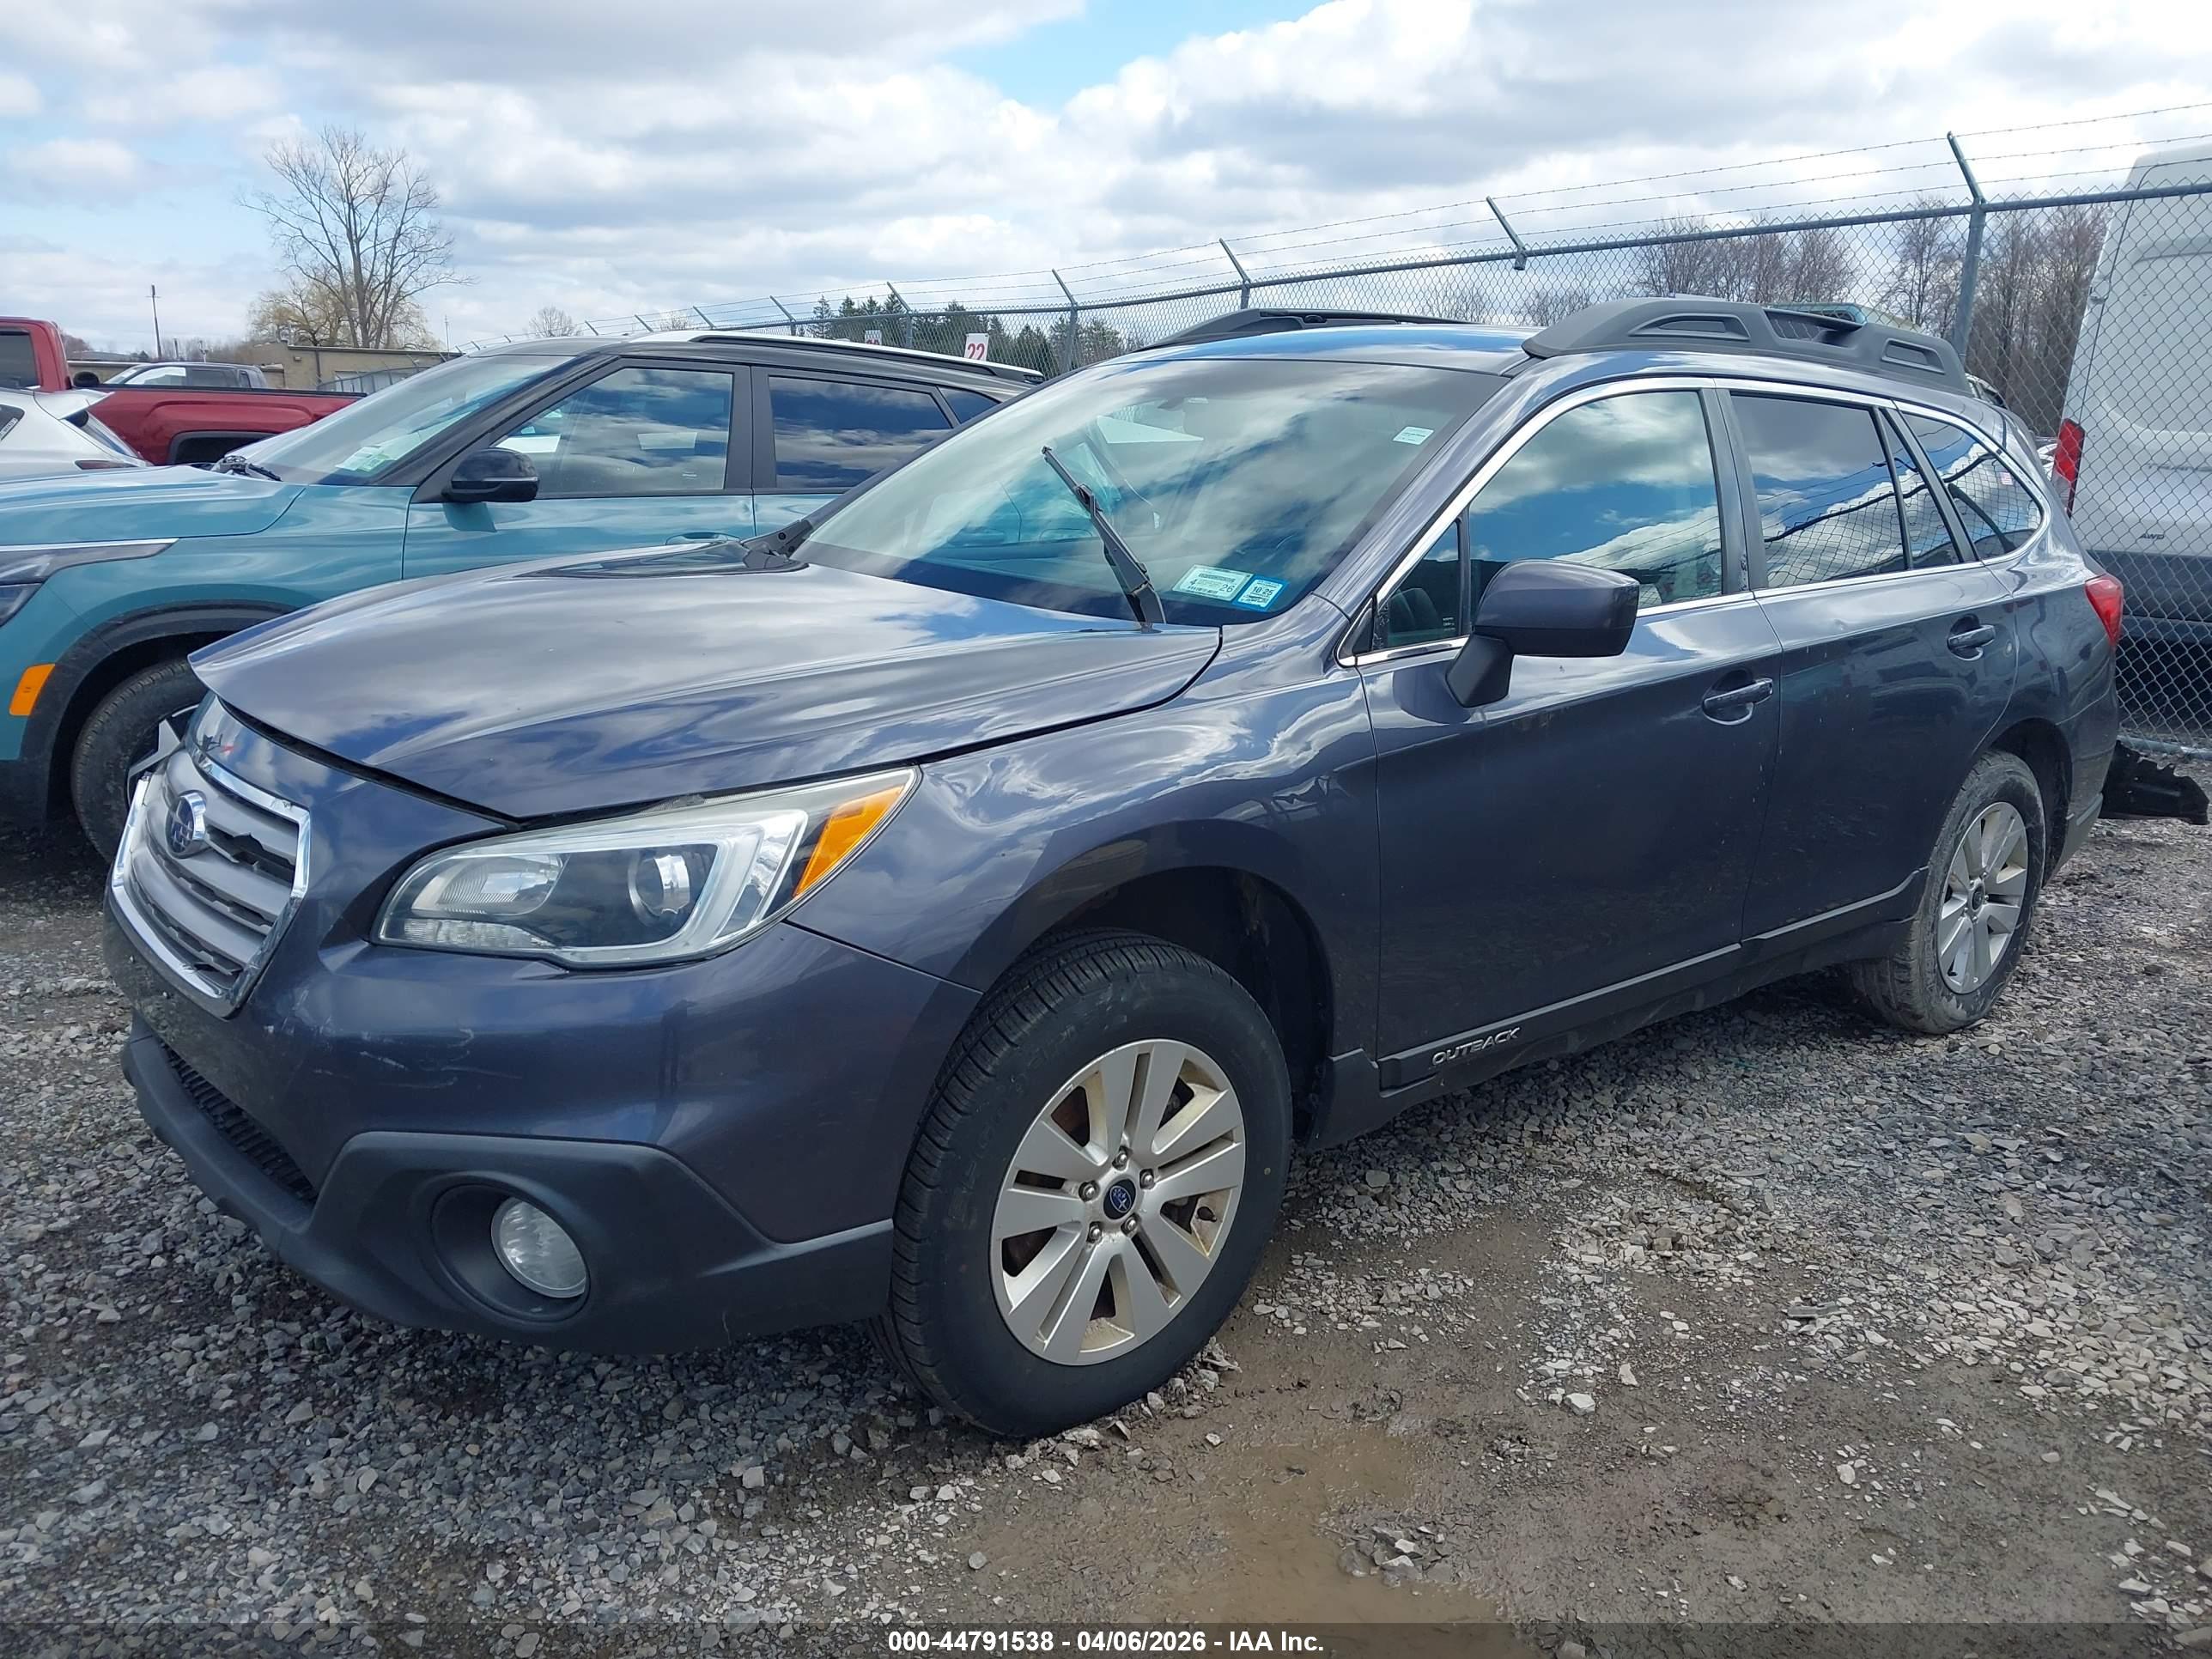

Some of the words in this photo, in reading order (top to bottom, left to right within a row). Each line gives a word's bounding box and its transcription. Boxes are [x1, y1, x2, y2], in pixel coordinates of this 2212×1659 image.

[967, 343, 985, 361] 22
[1218, 584, 1236, 592] 26
[1431, 1027, 1521, 1065] OUTBACK
